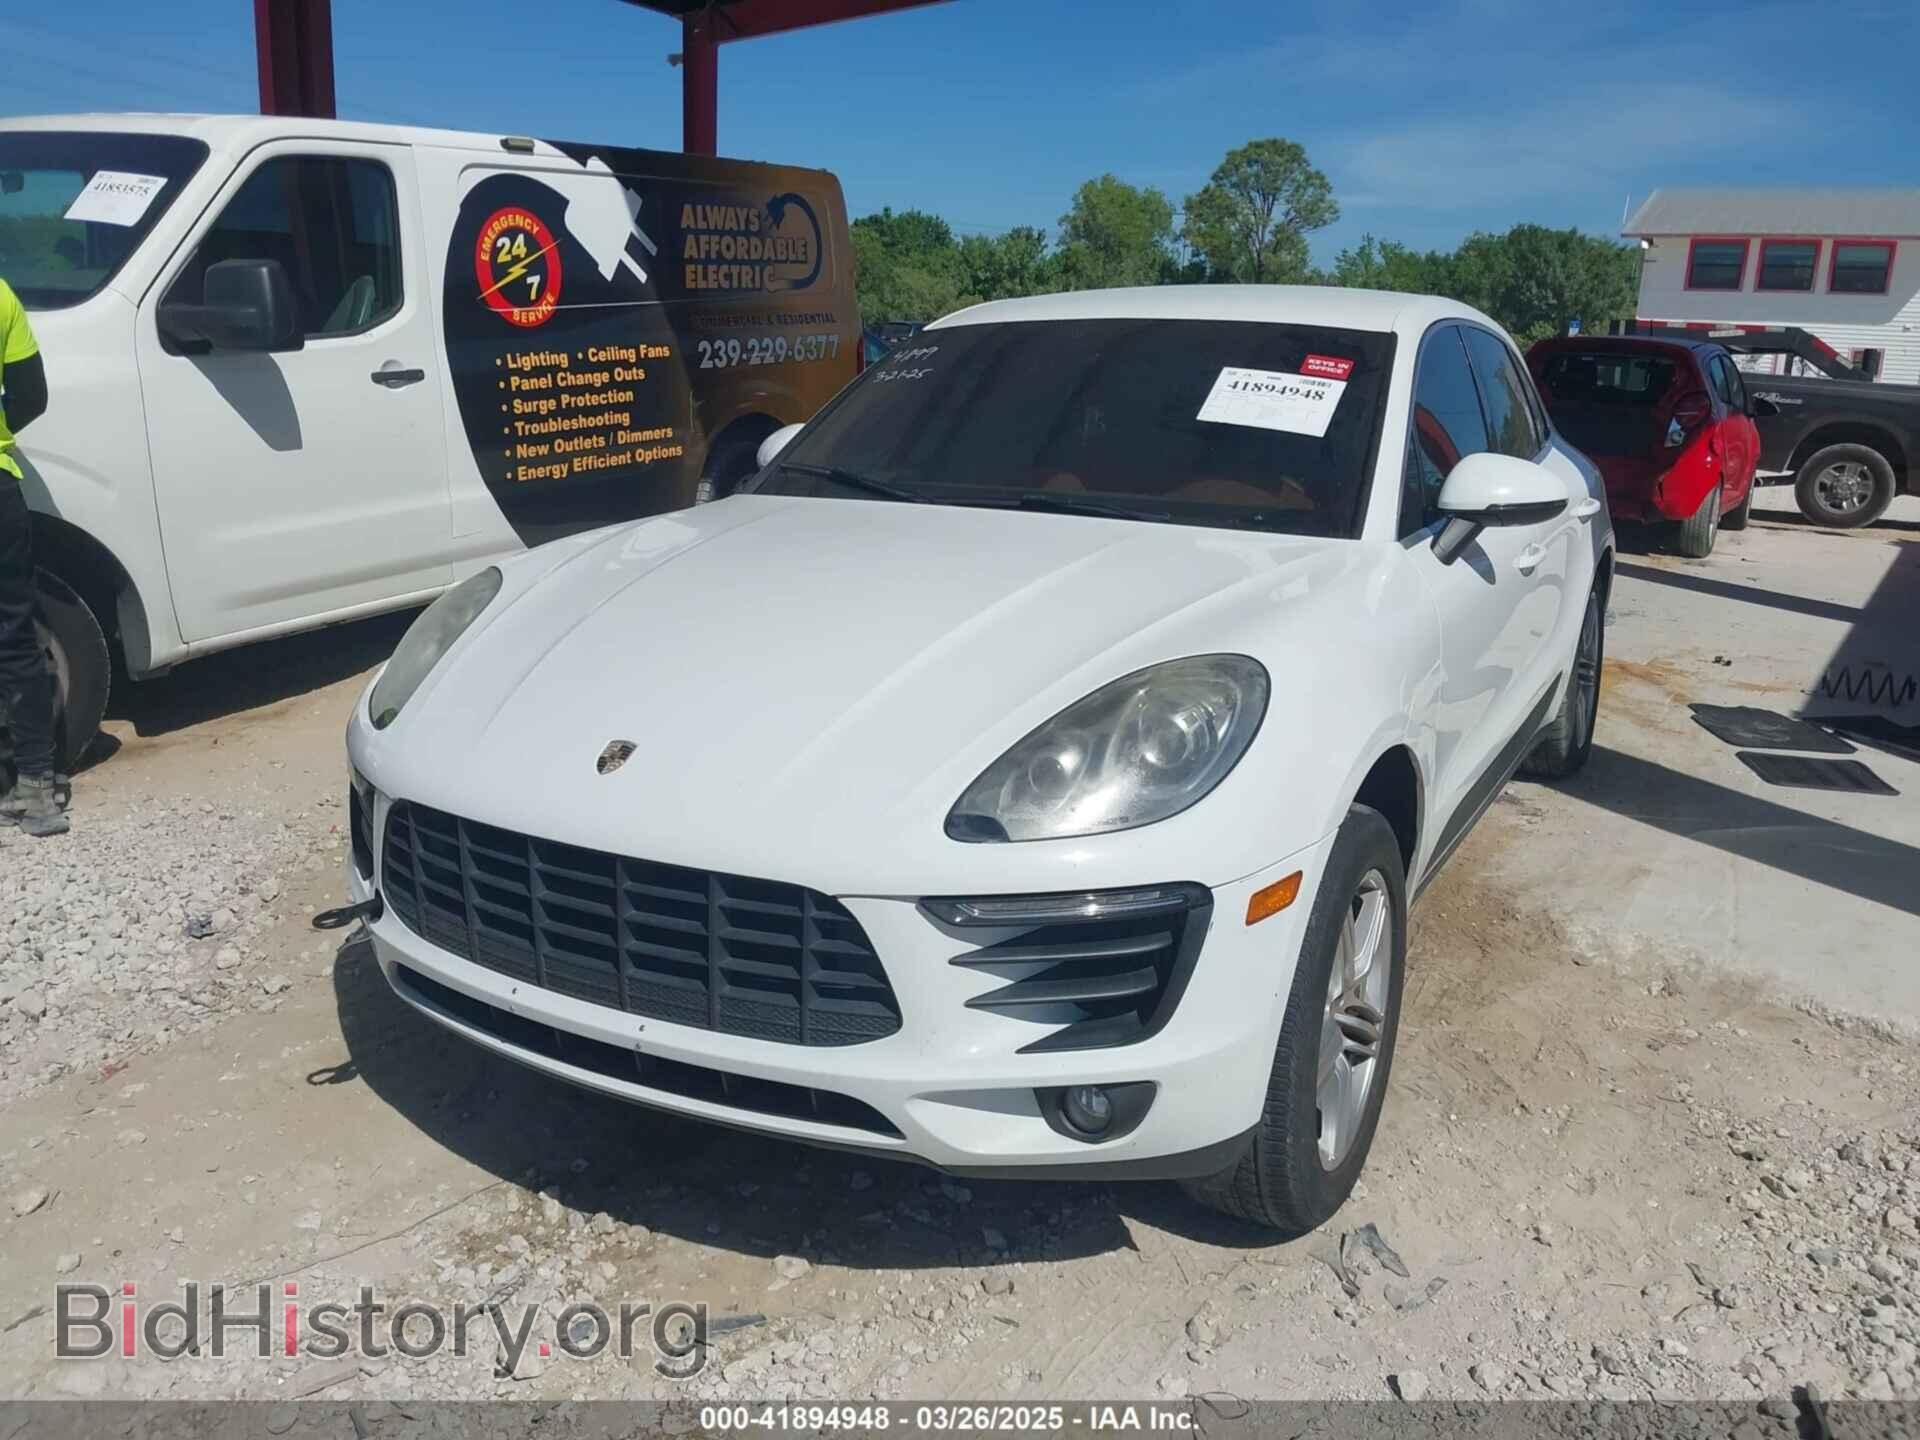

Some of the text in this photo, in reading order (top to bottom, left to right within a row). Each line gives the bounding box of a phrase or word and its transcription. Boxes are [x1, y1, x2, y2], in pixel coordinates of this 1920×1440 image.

[680, 204, 760, 232] ALWAYS
[480, 214, 540, 261] EMERGENCY
[496, 233, 527, 264] 24
[683, 234, 808, 264] AFFORDABLE
[526, 275, 540, 301] 7
[685, 264, 776, 292] ELECTRIC
[506, 351, 569, 371] Lighting
[588, 344, 671, 362] Ceiling Fans
[510, 367, 646, 391] Panel Change Outs
[1228, 380, 1325, 401] 41894948
[513, 389, 634, 415] Surge Protection
[514, 411, 631, 436] Troubleshooting
[516, 443, 550, 459] New
[554, 434, 606, 453] Outlets
[617, 427, 673, 445] Dimmers
[517, 445, 683, 481] Energy Efficient Options
